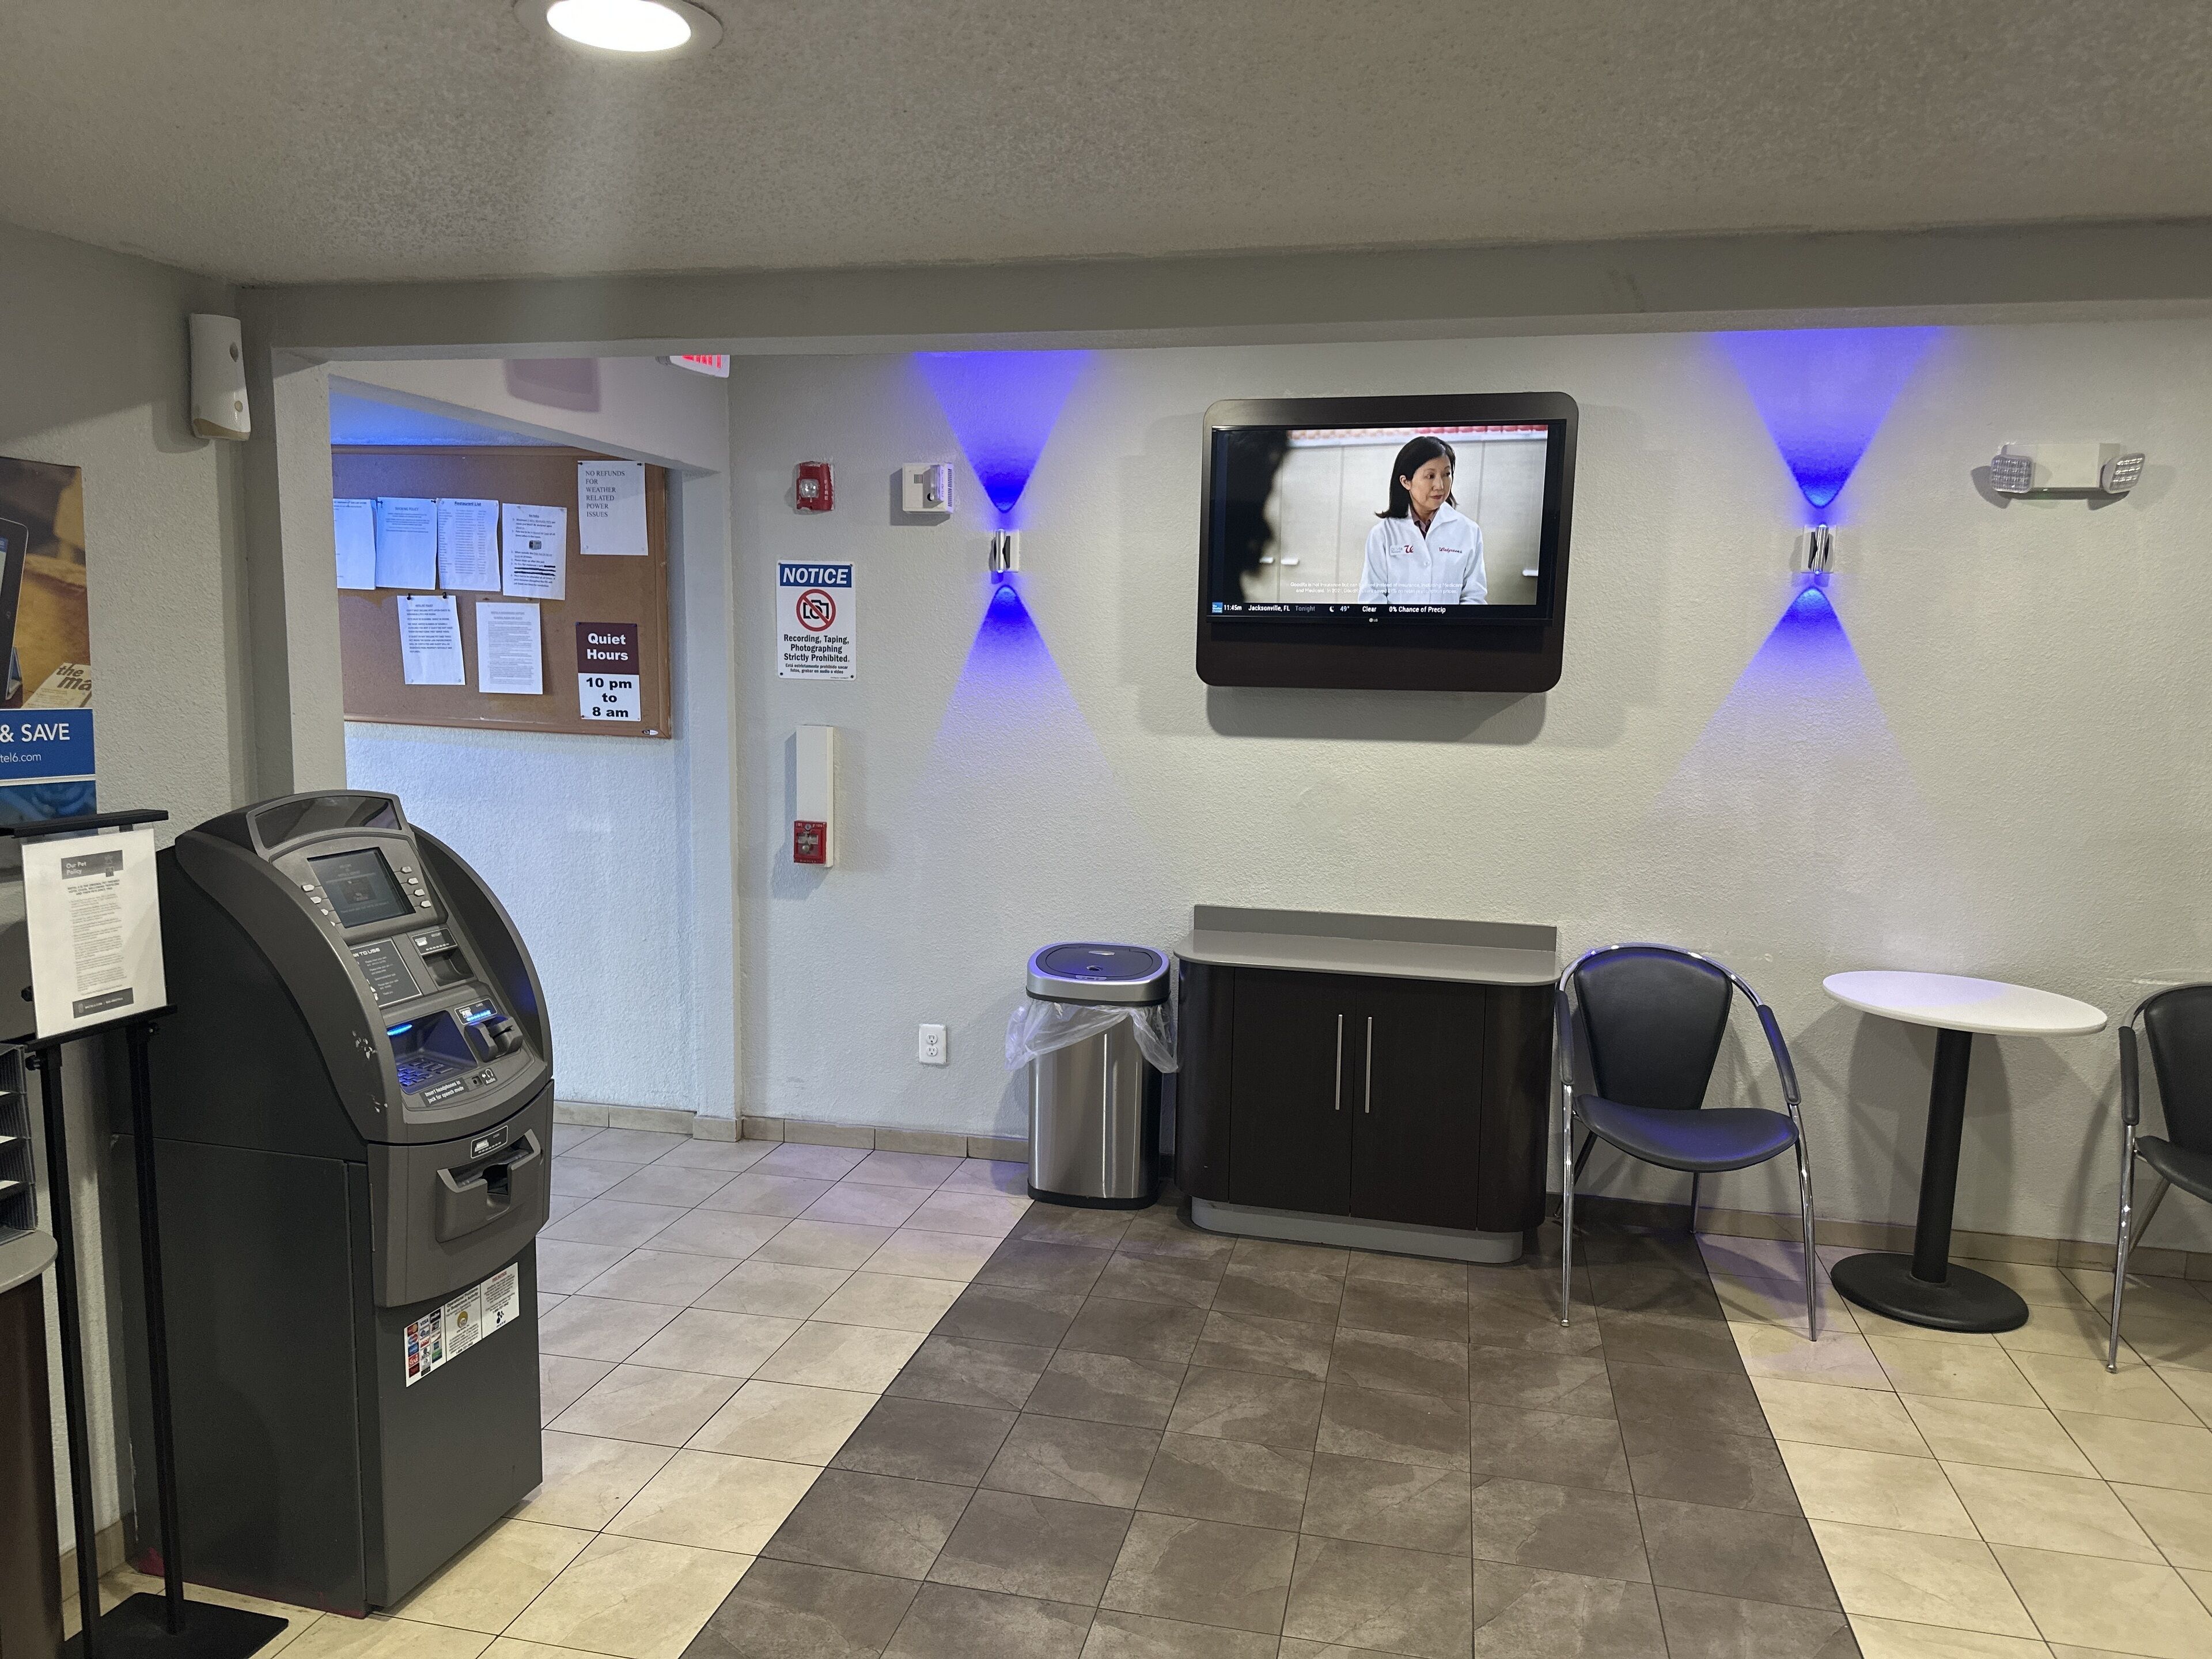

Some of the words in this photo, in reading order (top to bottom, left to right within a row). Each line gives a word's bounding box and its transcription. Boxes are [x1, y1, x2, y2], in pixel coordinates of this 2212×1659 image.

[783, 567, 849, 584] NOTICE
[588, 633, 626, 645] Quiet
[784, 634, 821, 644] Recording,
[823, 635, 849, 645] Taping,
[790, 644, 843, 654] Photographing
[586, 649, 628, 661] Hours
[784, 653, 809, 662] Strictly
[811, 654, 850, 662] Prohibited.
[56, 664, 84, 677] the
[586, 677, 604, 688] 10
[609, 680, 632, 691] pm
[602, 693, 617, 702] to
[592, 706, 601, 717] 8
[0, 724, 15, 743] &
[21, 723, 70, 743] SAVE
[435, 1082, 456, 1092] headphones
[442, 1089, 454, 1098] speech
[447, 1295, 464, 1308] Operational
[464, 1287, 478, 1298] Problems
[450, 1298, 467, 1310] Suspicious
[468, 1291, 478, 1300] Activity
[421, 1318, 429, 1326] VISA
